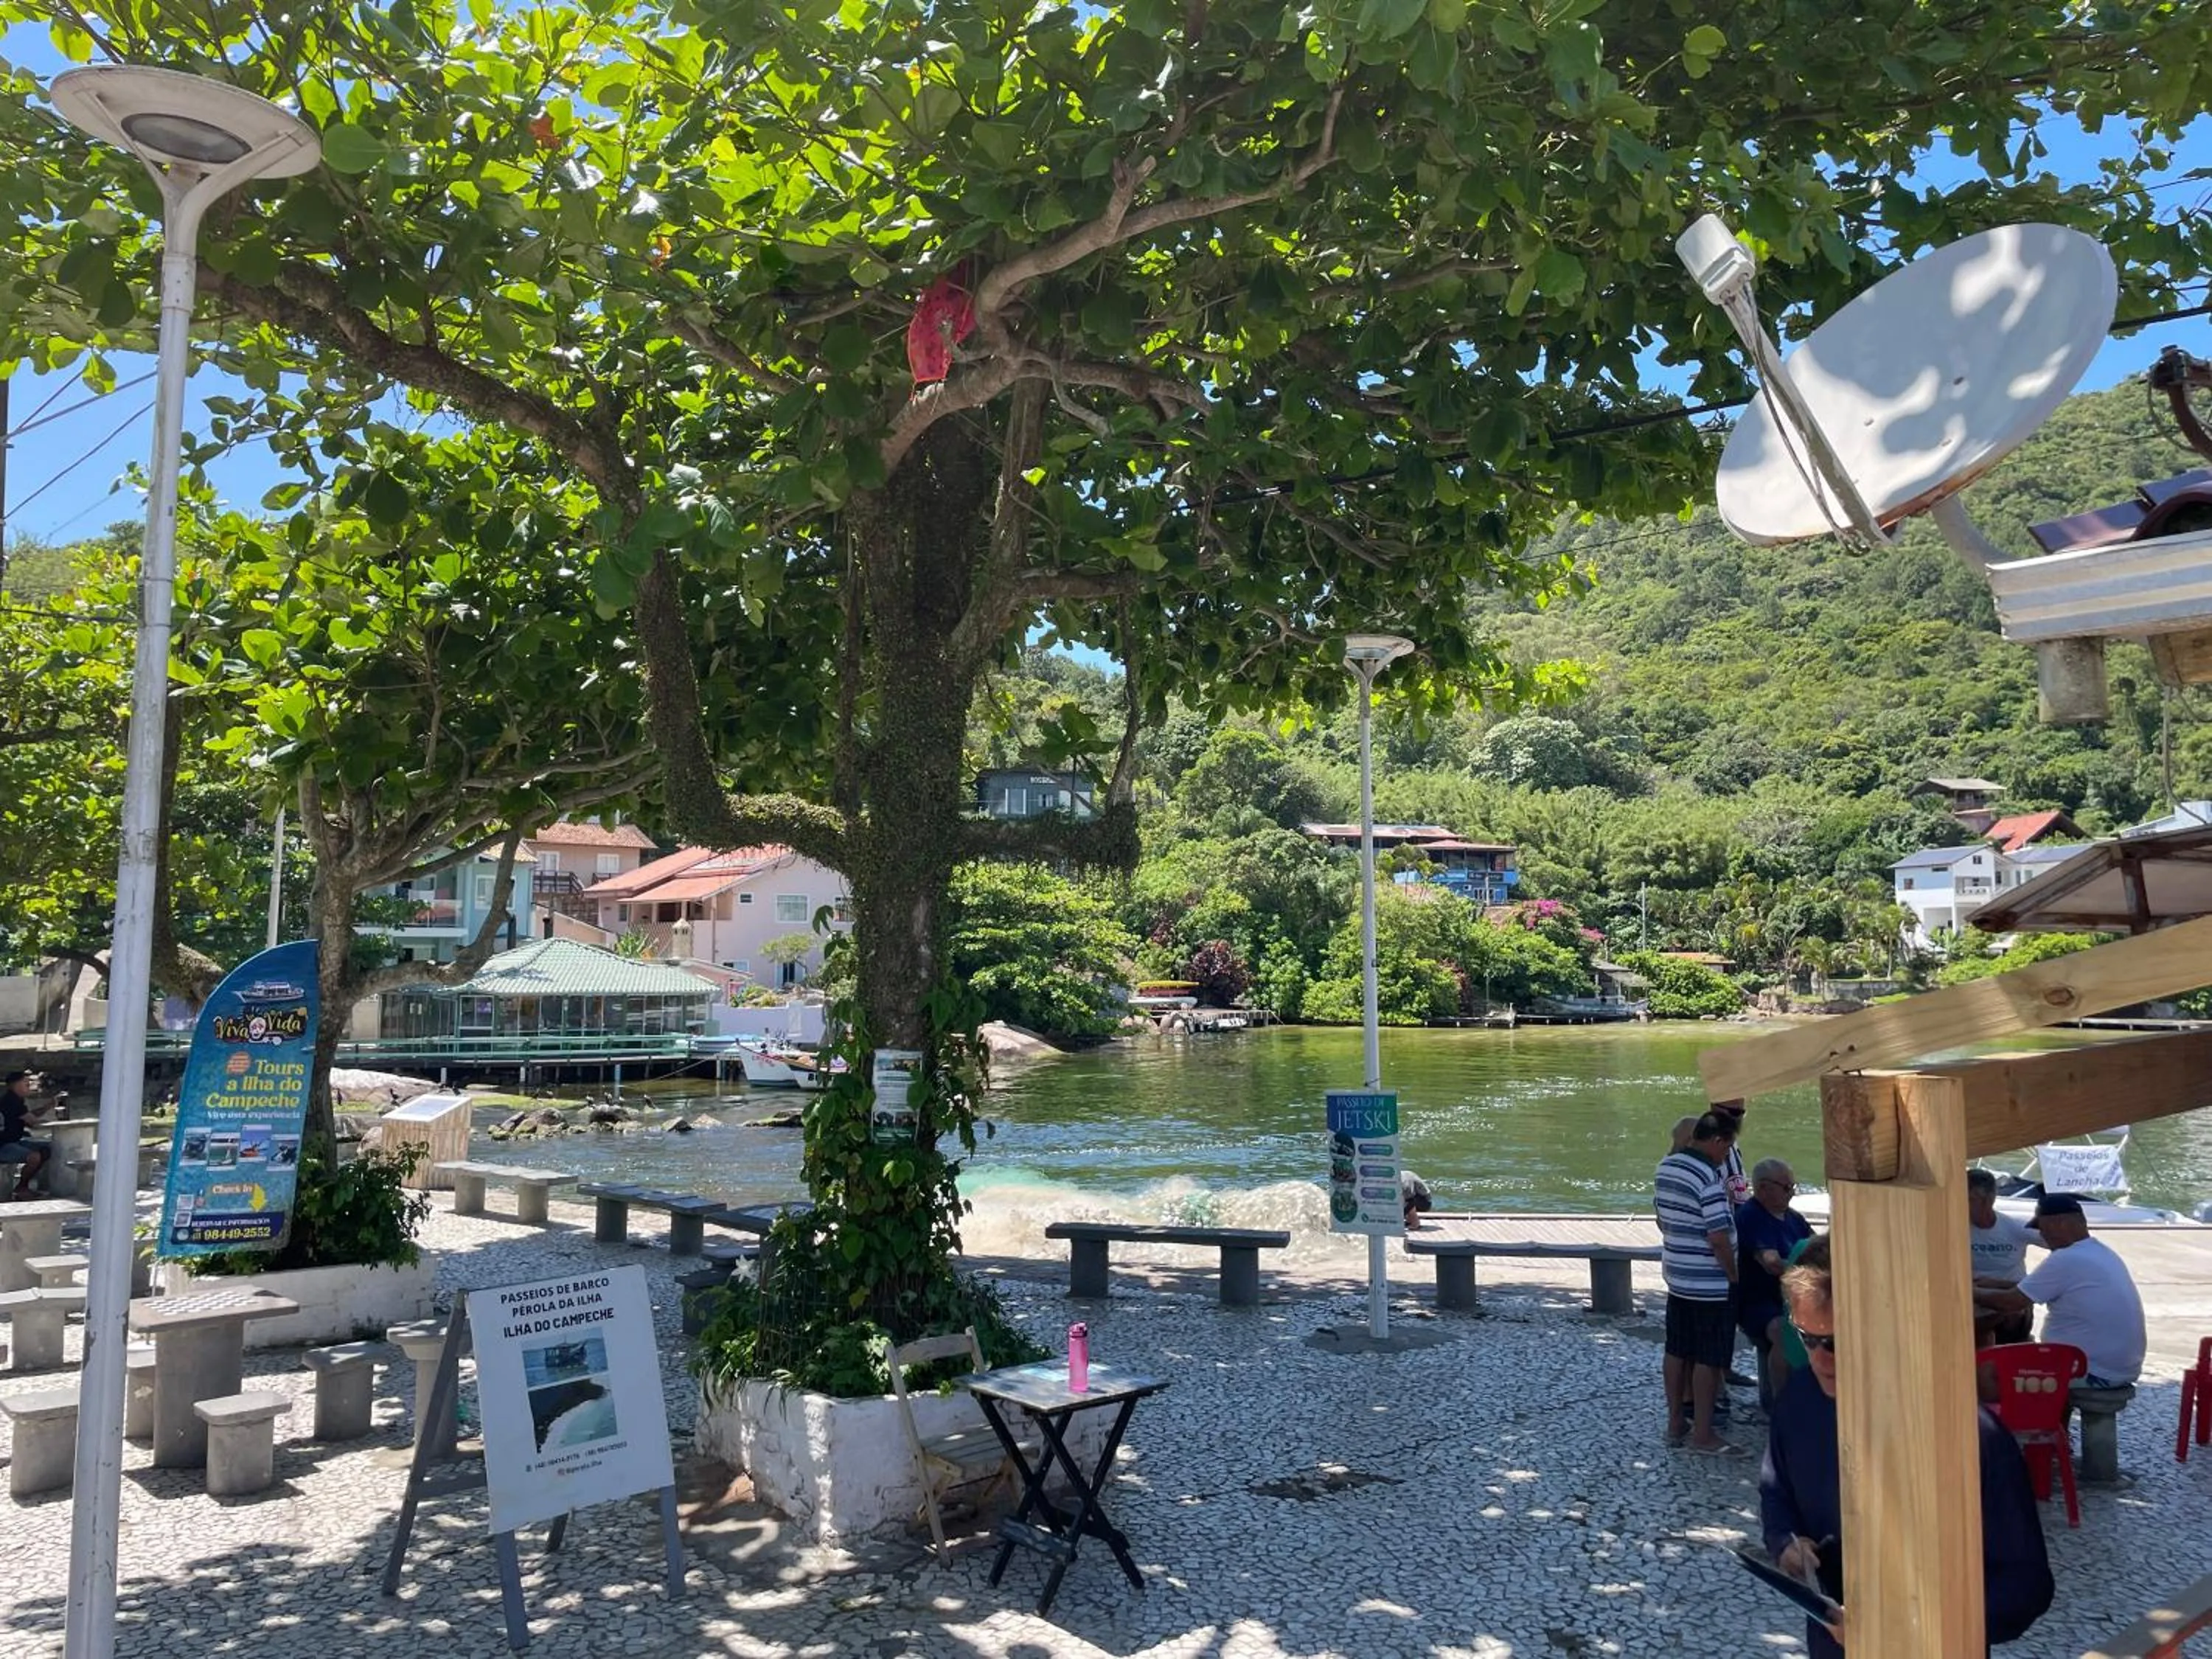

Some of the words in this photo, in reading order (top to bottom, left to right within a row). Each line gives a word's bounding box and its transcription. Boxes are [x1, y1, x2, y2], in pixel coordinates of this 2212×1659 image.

[264, 1011, 301, 1032] Vida
[254, 1060, 305, 1075] Tours
[226, 1079, 237, 1091] a
[243, 1076, 275, 1091] Ilha
[280, 1077, 302, 1091] do
[206, 1091, 299, 1110] Campeche
[1336, 1110, 1391, 1133] JETSKI
[2058, 1150, 2110, 1161] Passeios
[2074, 1164, 2088, 1174] de
[2056, 1177, 2100, 1187] Lancha
[1971, 1242, 2017, 1252] ceano.
[501, 1287, 554, 1304] PASSEIOS
[557, 1284, 571, 1295] DE
[573, 1278, 609, 1292] BARCO
[558, 1298, 575, 1310] DA
[577, 1293, 603, 1306] ILHA
[504, 1323, 532, 1338] ILHA
[535, 1320, 551, 1332] DO
[554, 1307, 614, 1329] CAMPECHE
